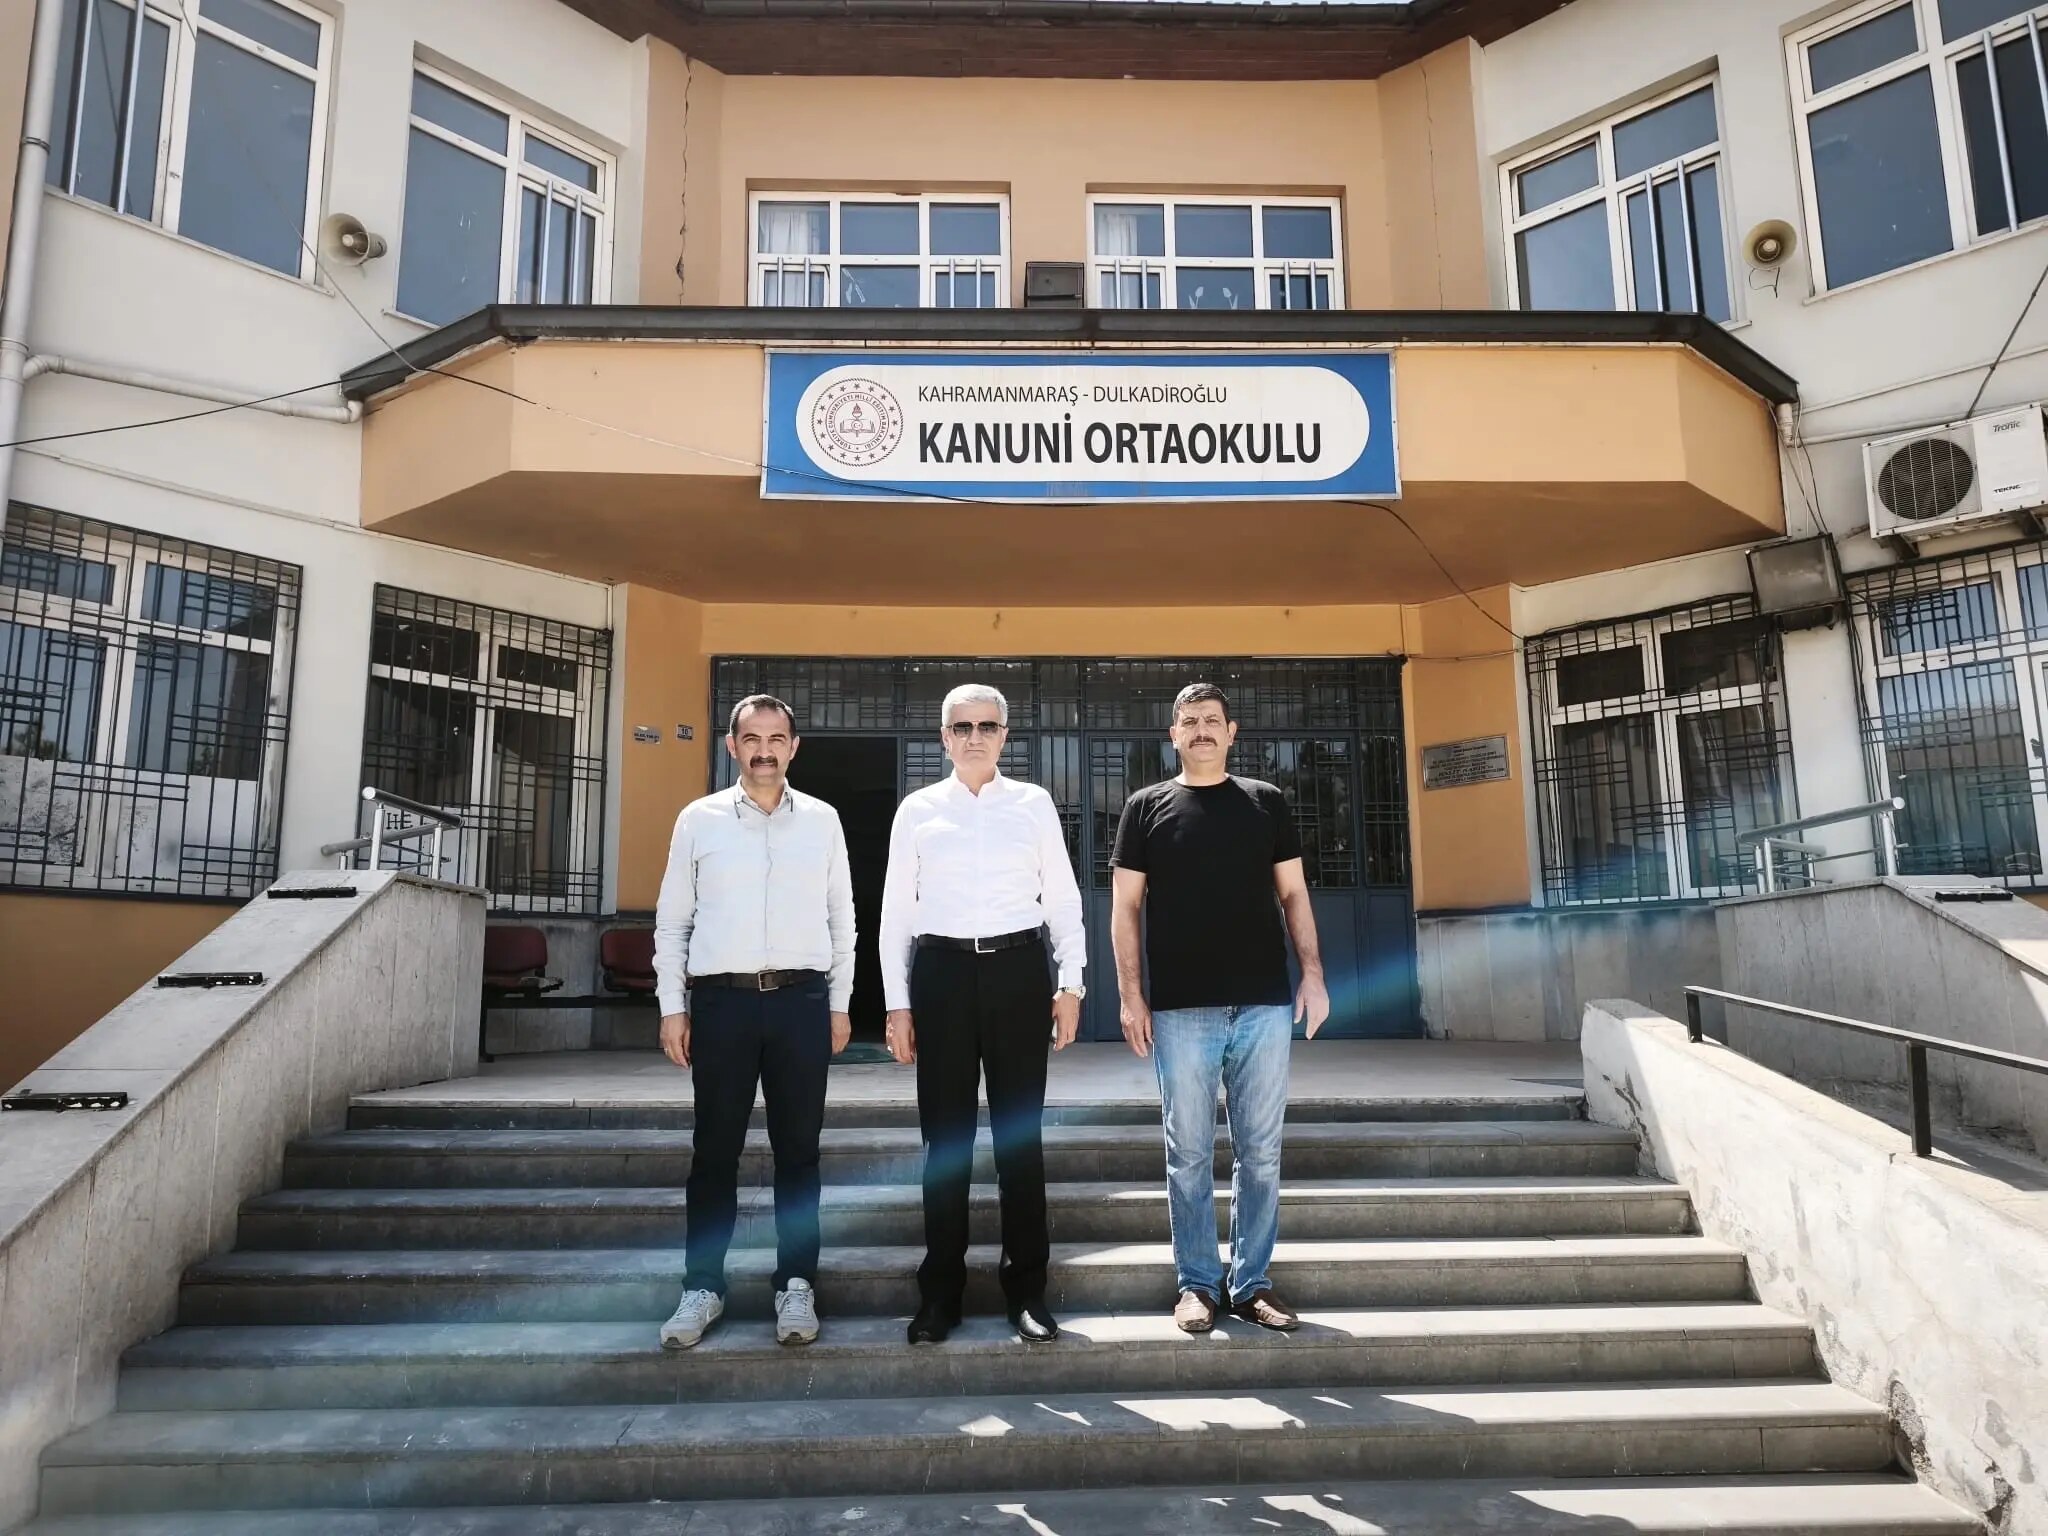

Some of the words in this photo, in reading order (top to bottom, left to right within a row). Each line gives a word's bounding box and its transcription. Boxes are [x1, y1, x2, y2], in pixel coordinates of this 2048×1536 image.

[918, 385, 1078, 406] KAHRAMANMARAŞ
[1093, 383, 1228, 403] DULKADİROĞLU
[919, 412, 1073, 464] KANUNİ
[1083, 421, 1322, 464] ORTAOKULU
